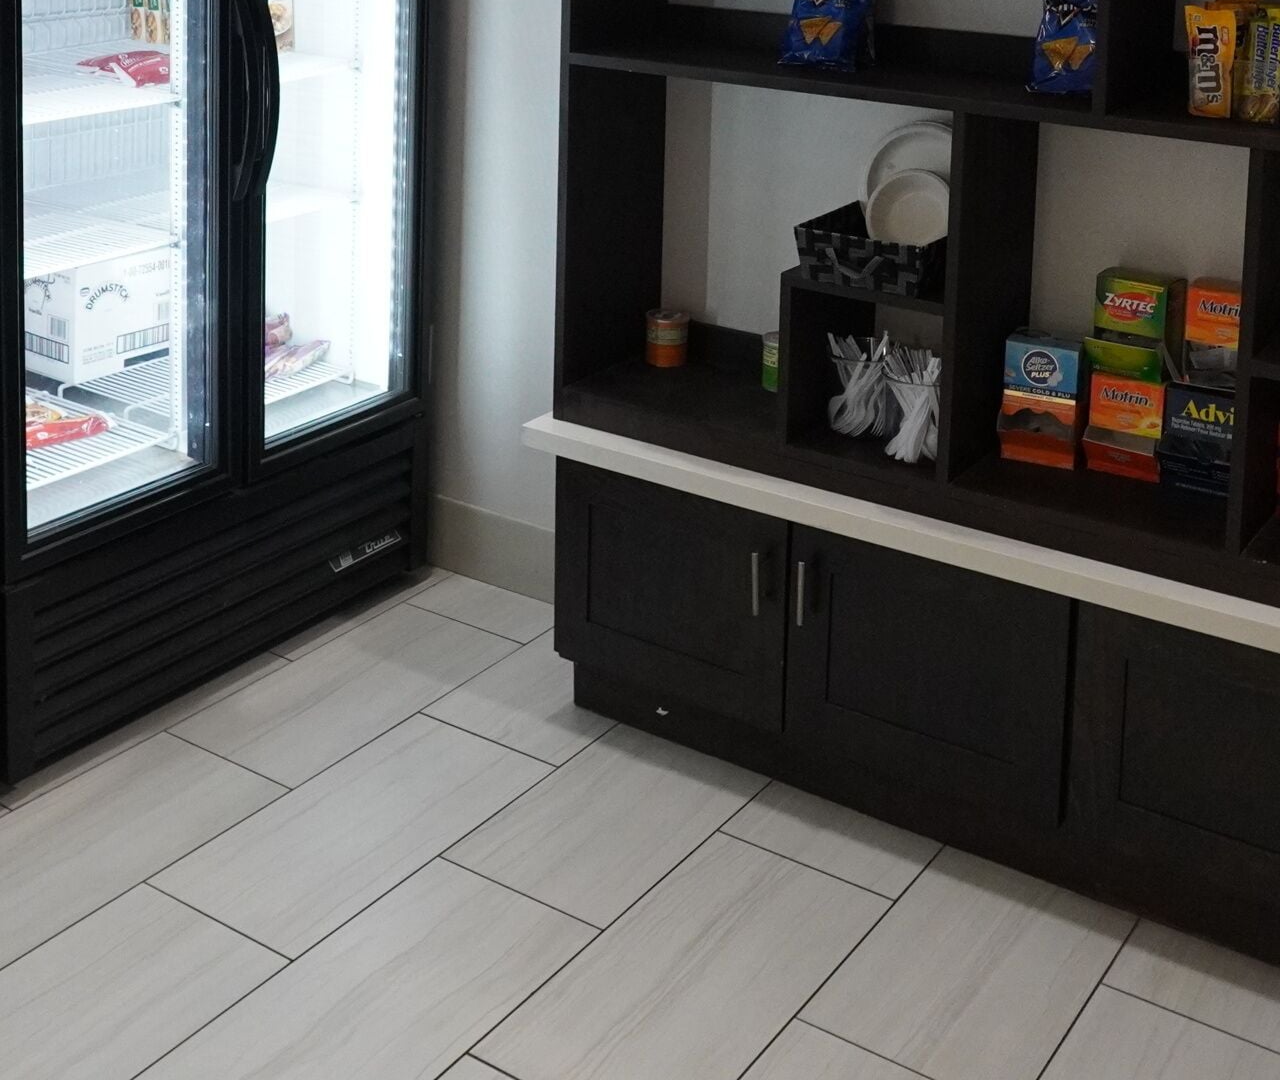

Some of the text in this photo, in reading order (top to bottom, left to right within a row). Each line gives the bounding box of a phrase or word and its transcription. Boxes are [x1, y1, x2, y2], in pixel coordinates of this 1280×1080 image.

[86, 283, 130, 311] DRUMSTICK
[1103, 292, 1157, 313] ZYRTEC
[1198, 298, 1241, 318] Motri
[1025, 363, 1055, 372] Seltzer
[1100, 386, 1149, 406] Motrin
[1181, 399, 1236, 426] Advi
